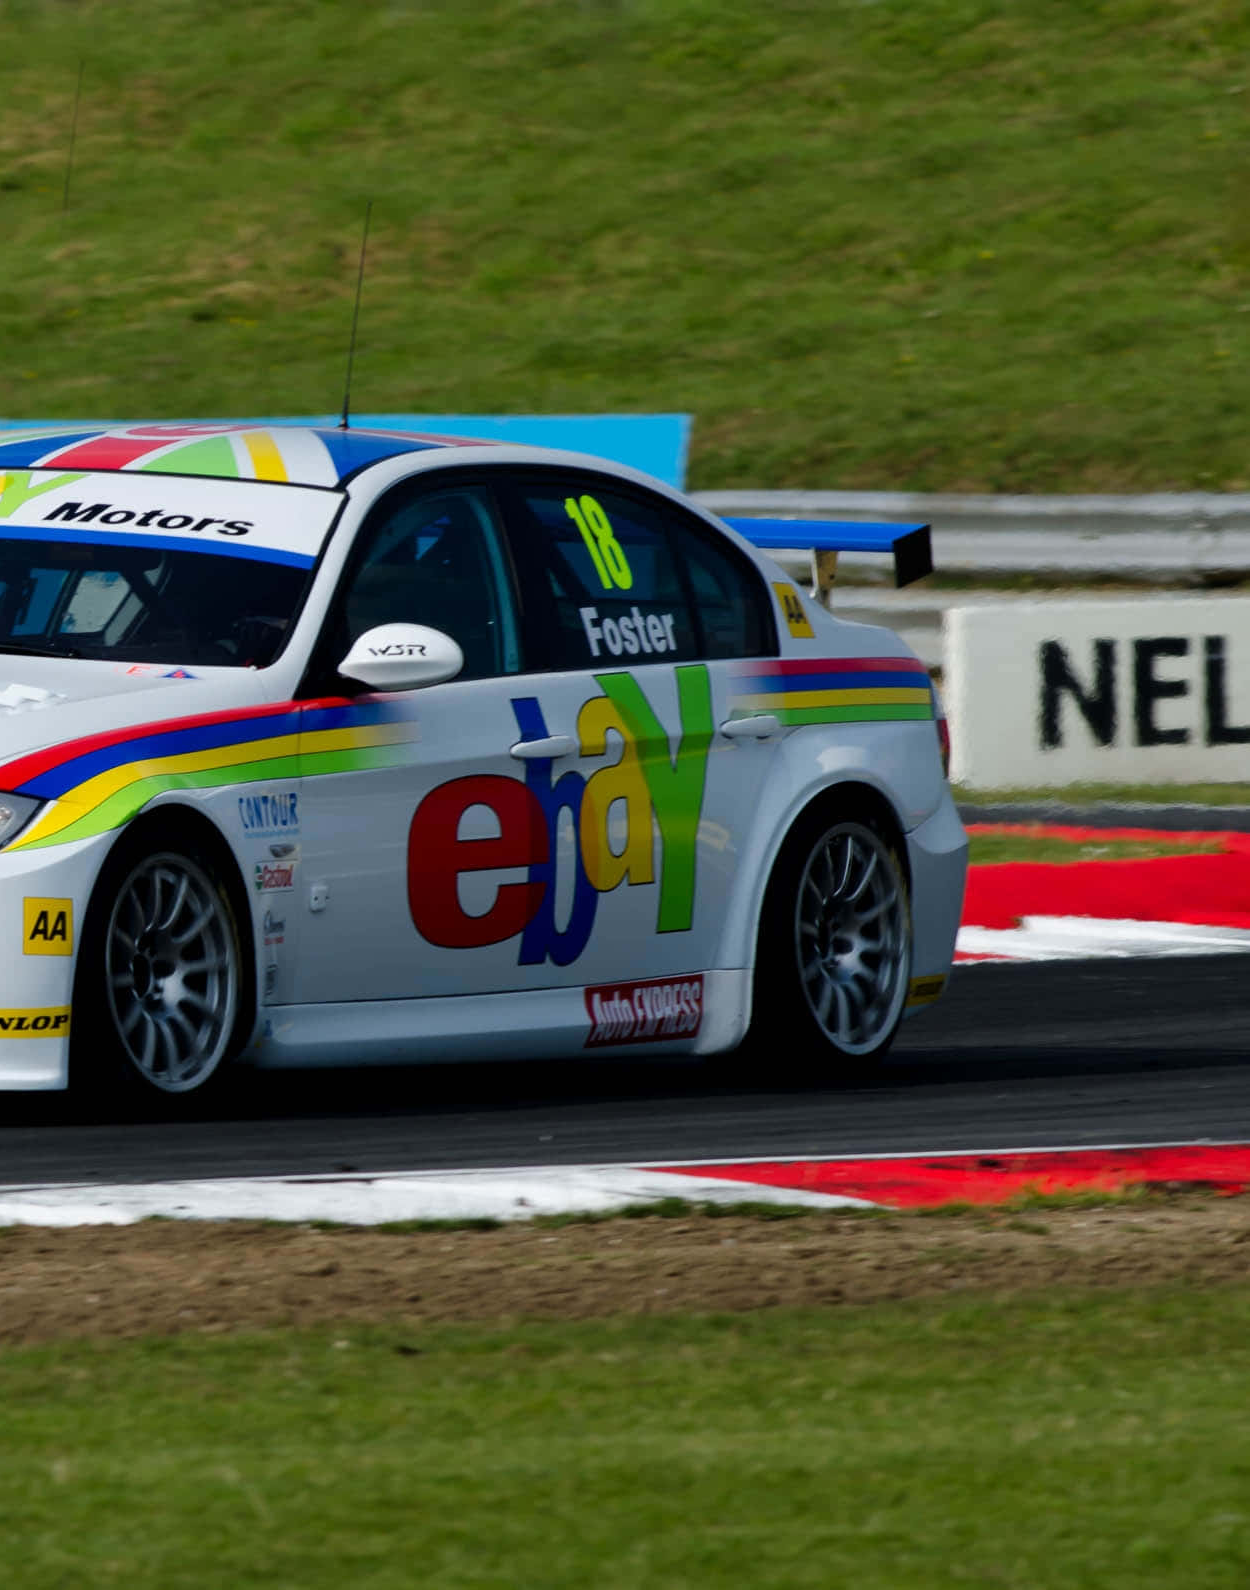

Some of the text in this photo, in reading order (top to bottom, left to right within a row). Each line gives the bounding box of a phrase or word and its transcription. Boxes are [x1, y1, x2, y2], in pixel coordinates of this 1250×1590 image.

[44, 502, 255, 537] Motors
[564, 495, 632, 590] 18
[579, 606, 677, 657] Foster
[1038, 635, 1250, 748] NEL
[29, 910, 68, 942] AA
